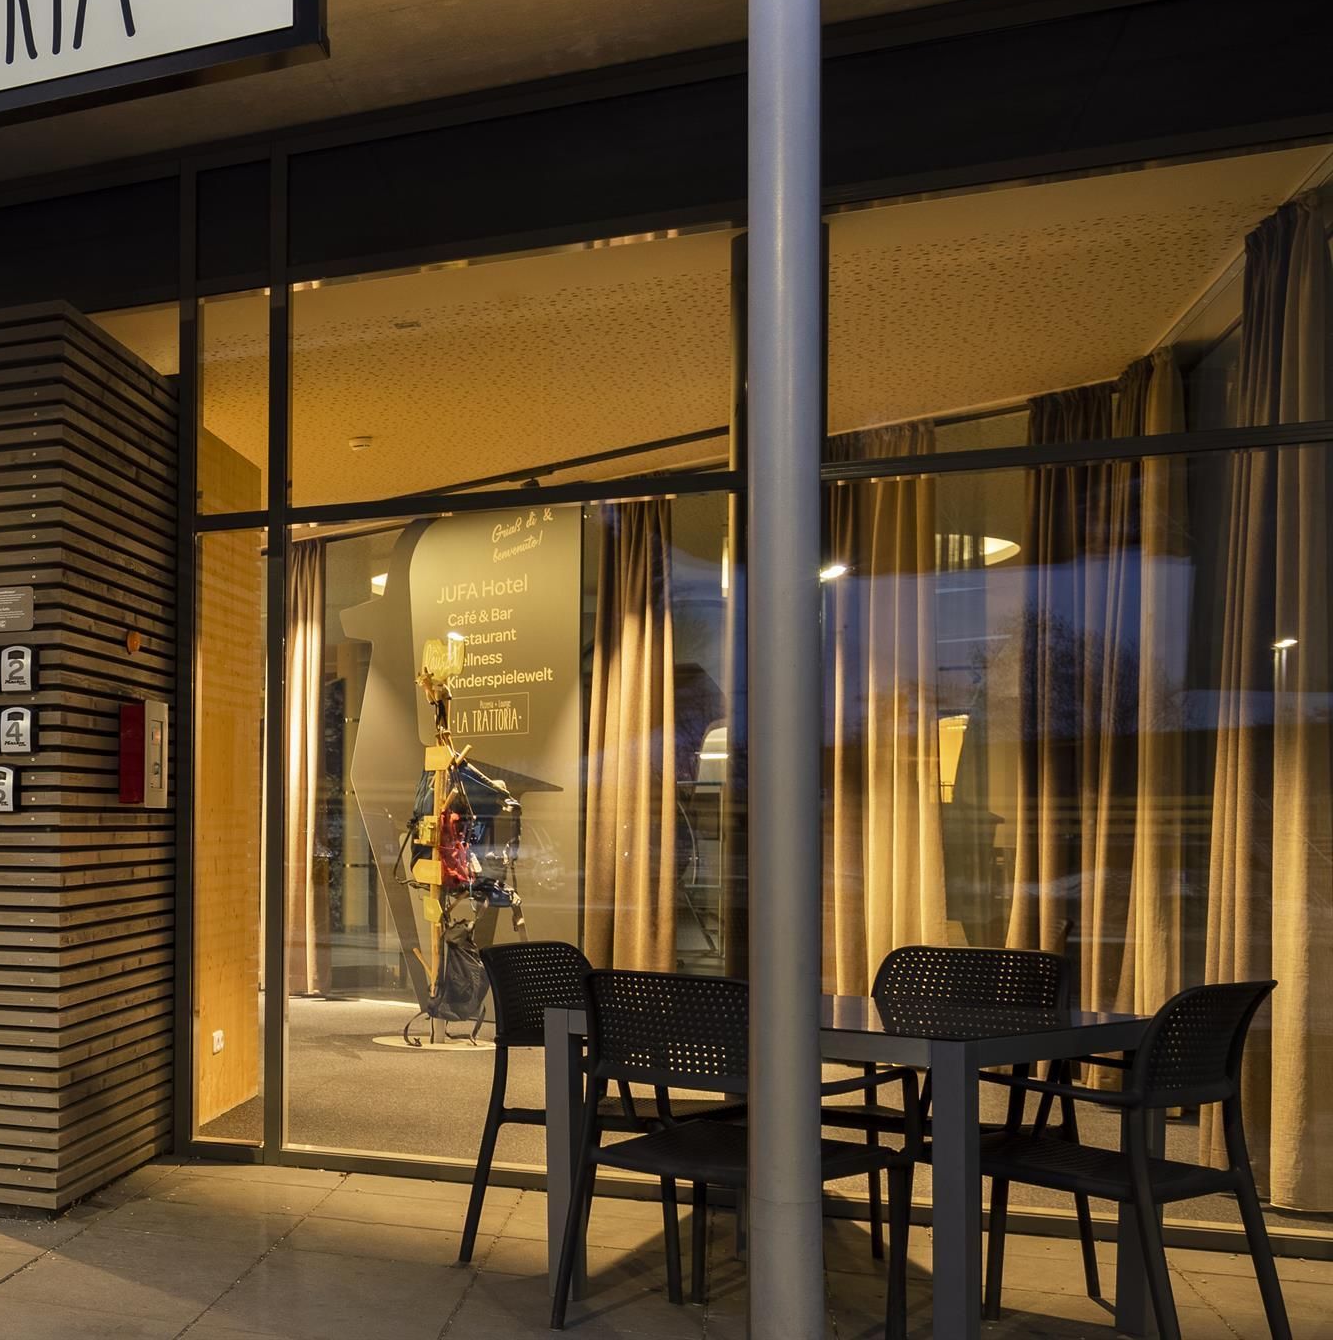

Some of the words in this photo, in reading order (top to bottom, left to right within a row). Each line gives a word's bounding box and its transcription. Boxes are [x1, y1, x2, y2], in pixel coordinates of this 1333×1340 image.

[542, 507, 554, 522] &
[436, 582, 479, 605] JUFA
[482, 574, 529, 599] Hotel
[447, 610, 477, 627] Café
[478, 610, 489, 623] &
[491, 607, 514, 622] Bar
[464, 628, 517, 646] staurant
[8, 660, 25, 680] 2
[446, 667, 554, 690] Kinderspielewelt
[456, 711, 469, 734] LA
[472, 707, 519, 733] TRATTORIA
[5, 722, 23, 742] 4
